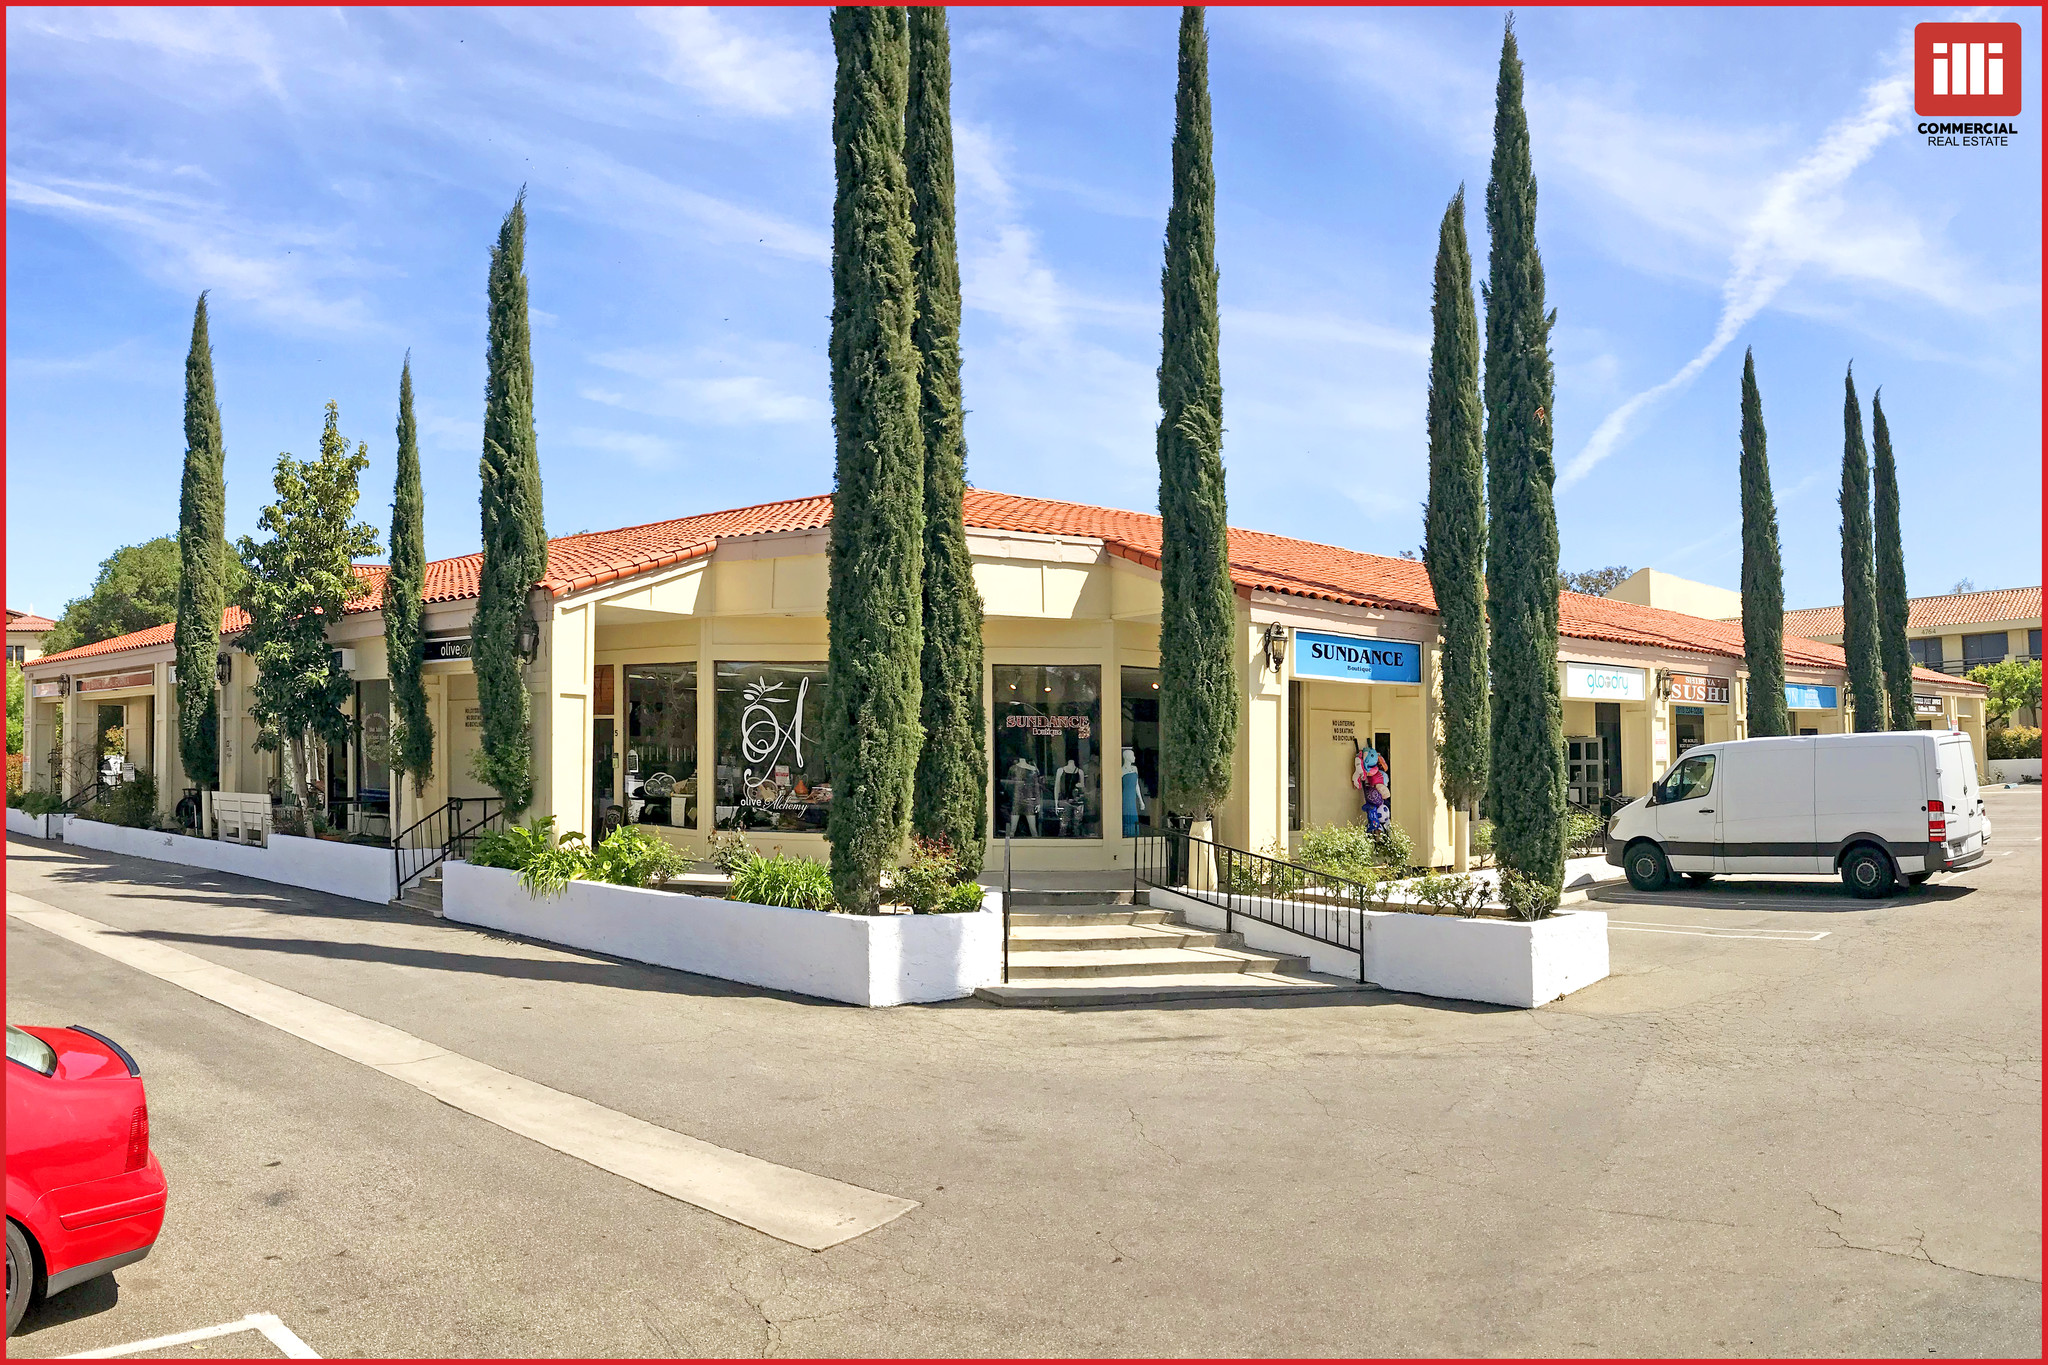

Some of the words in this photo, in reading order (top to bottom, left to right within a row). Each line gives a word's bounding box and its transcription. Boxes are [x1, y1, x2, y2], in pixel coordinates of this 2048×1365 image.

[440, 642, 461, 657] olive
[1311, 643, 1404, 667] SUNDANCE
[1347, 665, 1372, 674] Boutique
[1684, 676, 1716, 687] SHIBUYA
[1671, 683, 1729, 702] SUSHI
[1006, 715, 1089, 728] SUNDANCE
[614, 729, 619, 737] 5
[1032, 728, 1063, 737] Boutique
[740, 797, 762, 807] olive
[763, 794, 808, 819] Alchemy
